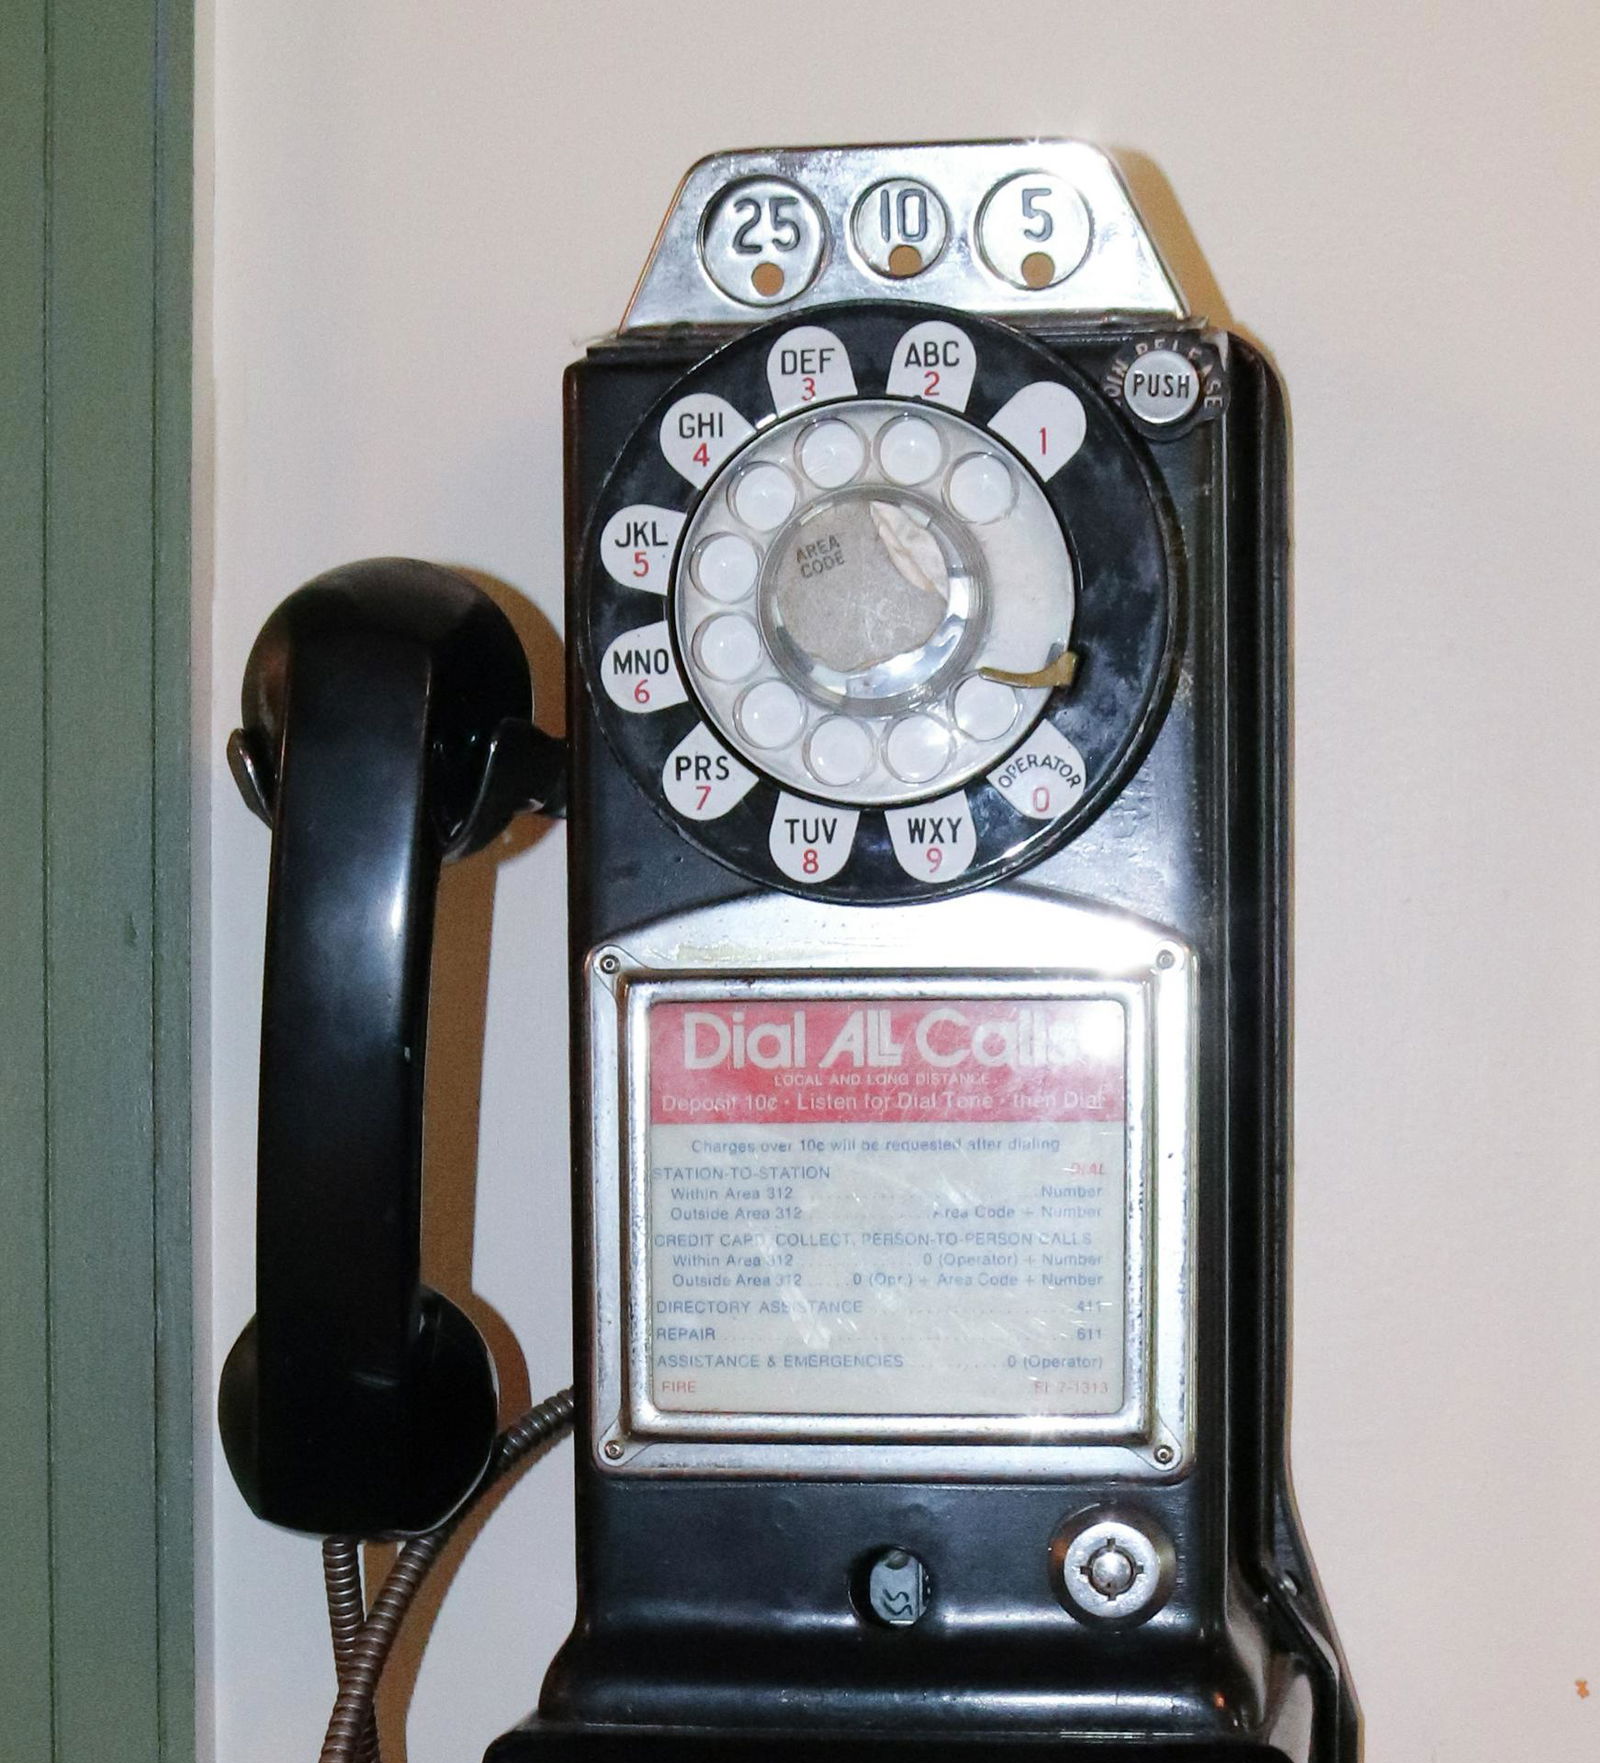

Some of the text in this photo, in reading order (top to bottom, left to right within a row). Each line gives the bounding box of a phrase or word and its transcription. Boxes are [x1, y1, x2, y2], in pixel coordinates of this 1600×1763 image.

[732, 196, 801, 256] 25
[878, 188, 928, 244] 10
[1020, 187, 1054, 243] 5
[780, 349, 834, 376] DEF
[902, 340, 961, 368] ABC
[800, 376, 817, 402] 3
[923, 371, 941, 396] 2
[1133, 373, 1190, 399] PUSH
[677, 411, 725, 439] GHI
[1037, 426, 1048, 456] 1
[692, 442, 711, 468] 4
[613, 522, 668, 549] JKL
[796, 534, 840, 563] AREA
[632, 552, 649, 578] 5
[800, 550, 845, 578] CODE
[612, 648, 670, 676] MNO
[633, 679, 650, 705] 6
[674, 753, 730, 782] PRS
[998, 754, 1082, 789] OPERATOR
[695, 786, 712, 811] 7
[784, 818, 837, 845] TUV
[906, 817, 963, 845] WXY
[802, 849, 819, 875] 8
[925, 848, 942, 873] 9
[682, 1008, 1079, 1070] Dial ALL Calls
[774, 1072, 990, 1087] LOCAL AND LONG DISTANCE
[661, 1095, 736, 1114] Deposit
[797, 1093, 857, 1110] Listen
[864, 1092, 891, 1110] for
[897, 1092, 937, 1110] Dial
[945, 1092, 993, 1110] Tone
[1012, 1091, 1057, 1109] then
[692, 1139, 754, 1156] Charges
[761, 1141, 792, 1152] over
[830, 1138, 856, 1151] will
[862, 1138, 879, 1151] be
[886, 1138, 962, 1154] requested
[968, 1138, 1001, 1150] after
[1008, 1137, 1060, 1153] dialing
[652, 1166, 830, 1180] STATION-TO-STATION
[671, 1186, 793, 1200] Within Area 312
[1041, 1184, 1102, 1198] Number
[670, 1206, 802, 1221] Outside Area 312
[974, 1205, 1016, 1218] Code
[1041, 1205, 1102, 1218] Number
[654, 1233, 714, 1248] CREDIT
[862, 1231, 1033, 1247] PERSON-TO-PERSON
[672, 1254, 720, 1267] Within
[726, 1254, 761, 1267] Area
[938, 1252, 1019, 1268] (Operator)
[1041, 1253, 1102, 1266] Number
[672, 1273, 731, 1287] Outside
[735, 1273, 771, 1286] Area
[936, 1272, 973, 1286] Area
[978, 1271, 1018, 1286] Code
[1041, 1272, 1103, 1286] Number
[656, 1300, 750, 1315] DIRECTORY
[656, 1327, 716, 1341] REPAIR
[1076, 1327, 1102, 1341] 611
[657, 1354, 904, 1368] ASSISTANCE & EMERGENCIES
[1022, 1355, 1103, 1370] (Operator)
[661, 1380, 697, 1393] FIRE
